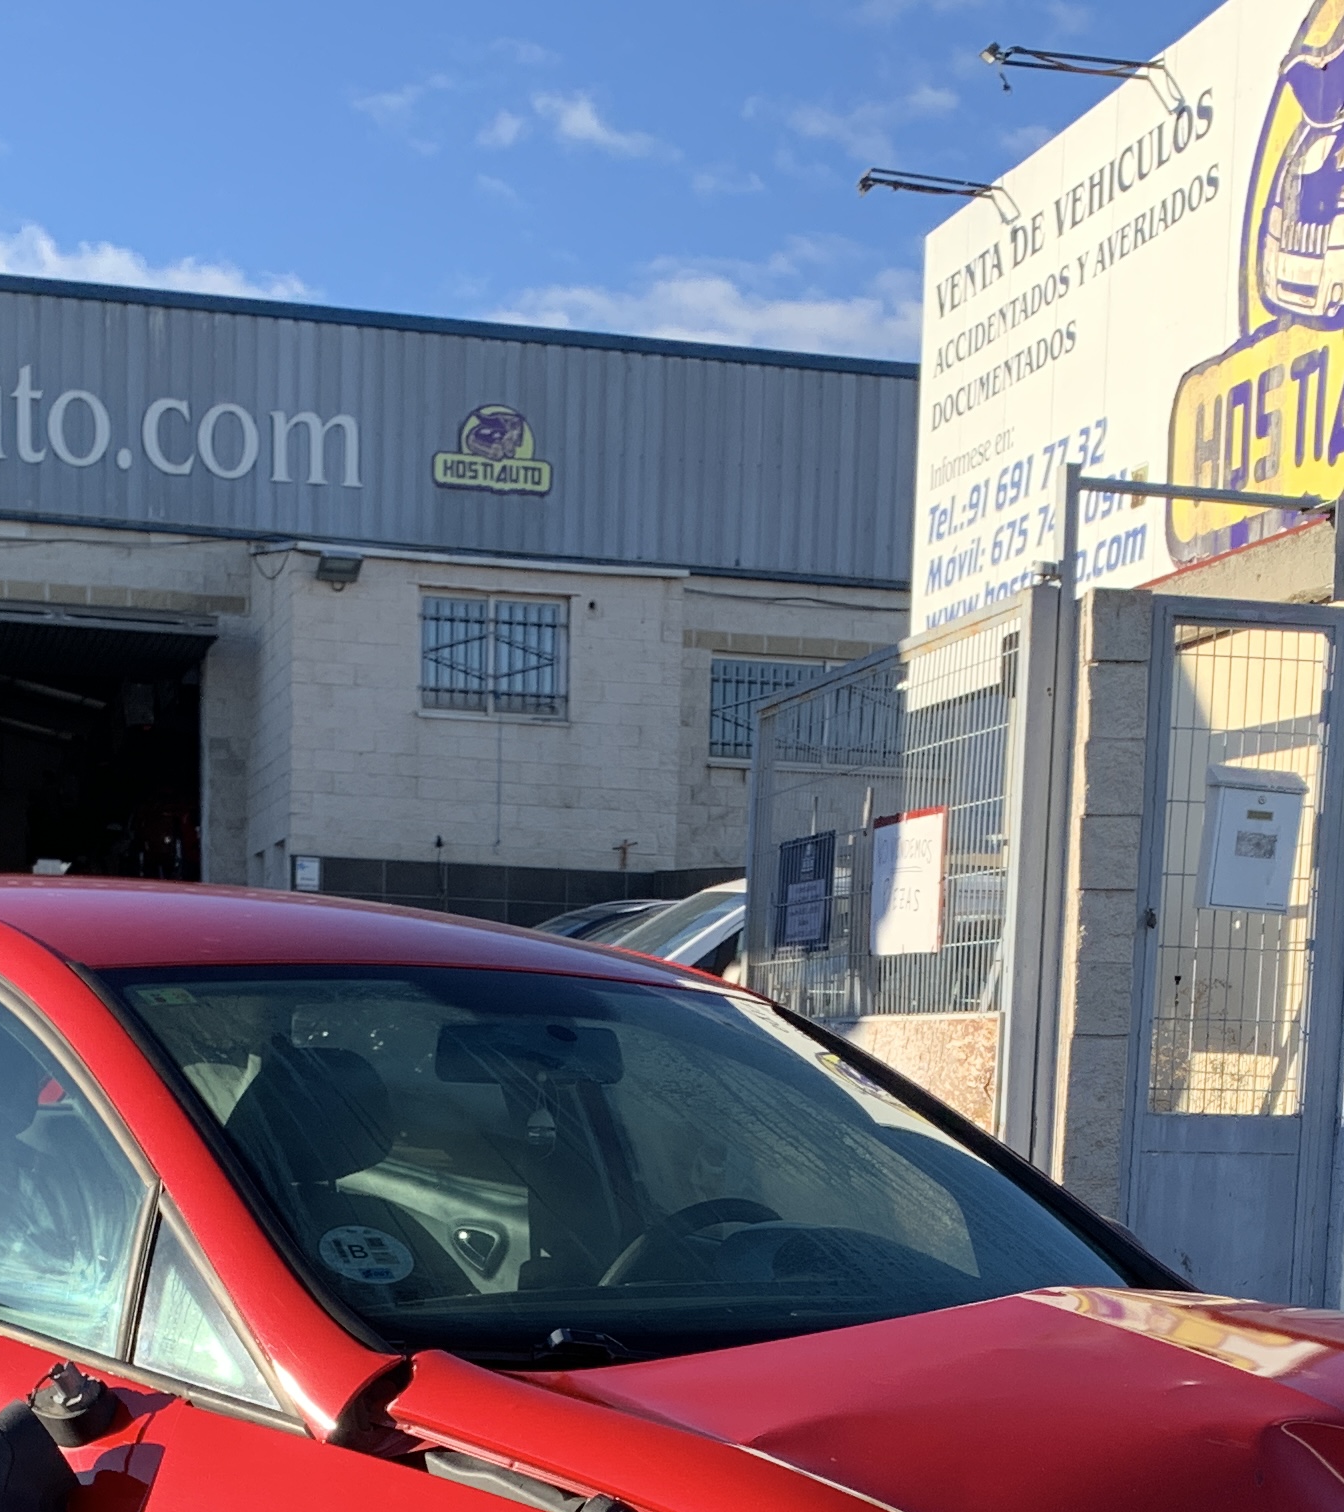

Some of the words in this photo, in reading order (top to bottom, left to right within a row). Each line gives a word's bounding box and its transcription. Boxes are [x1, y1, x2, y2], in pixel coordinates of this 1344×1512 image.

[936, 241, 1004, 320] VENTA
[1010, 210, 1046, 269] DE
[1054, 87, 1214, 238] VEHICULOS
[932, 263, 1071, 379] ACCIDENTADOS
[1076, 251, 1091, 288] Y
[1092, 162, 1220, 278] AVERIADOS
[931, 319, 1077, 433] DOCUMENTADOS
[443, 459, 542, 485] HOSTIAUTO
[994, 454, 1034, 513] 691
[1077, 416, 1108, 472] 32
[924, 536, 986, 597] Móvil:
[990, 512, 1030, 567] 675
[347, 1244, 368, 1259] B
